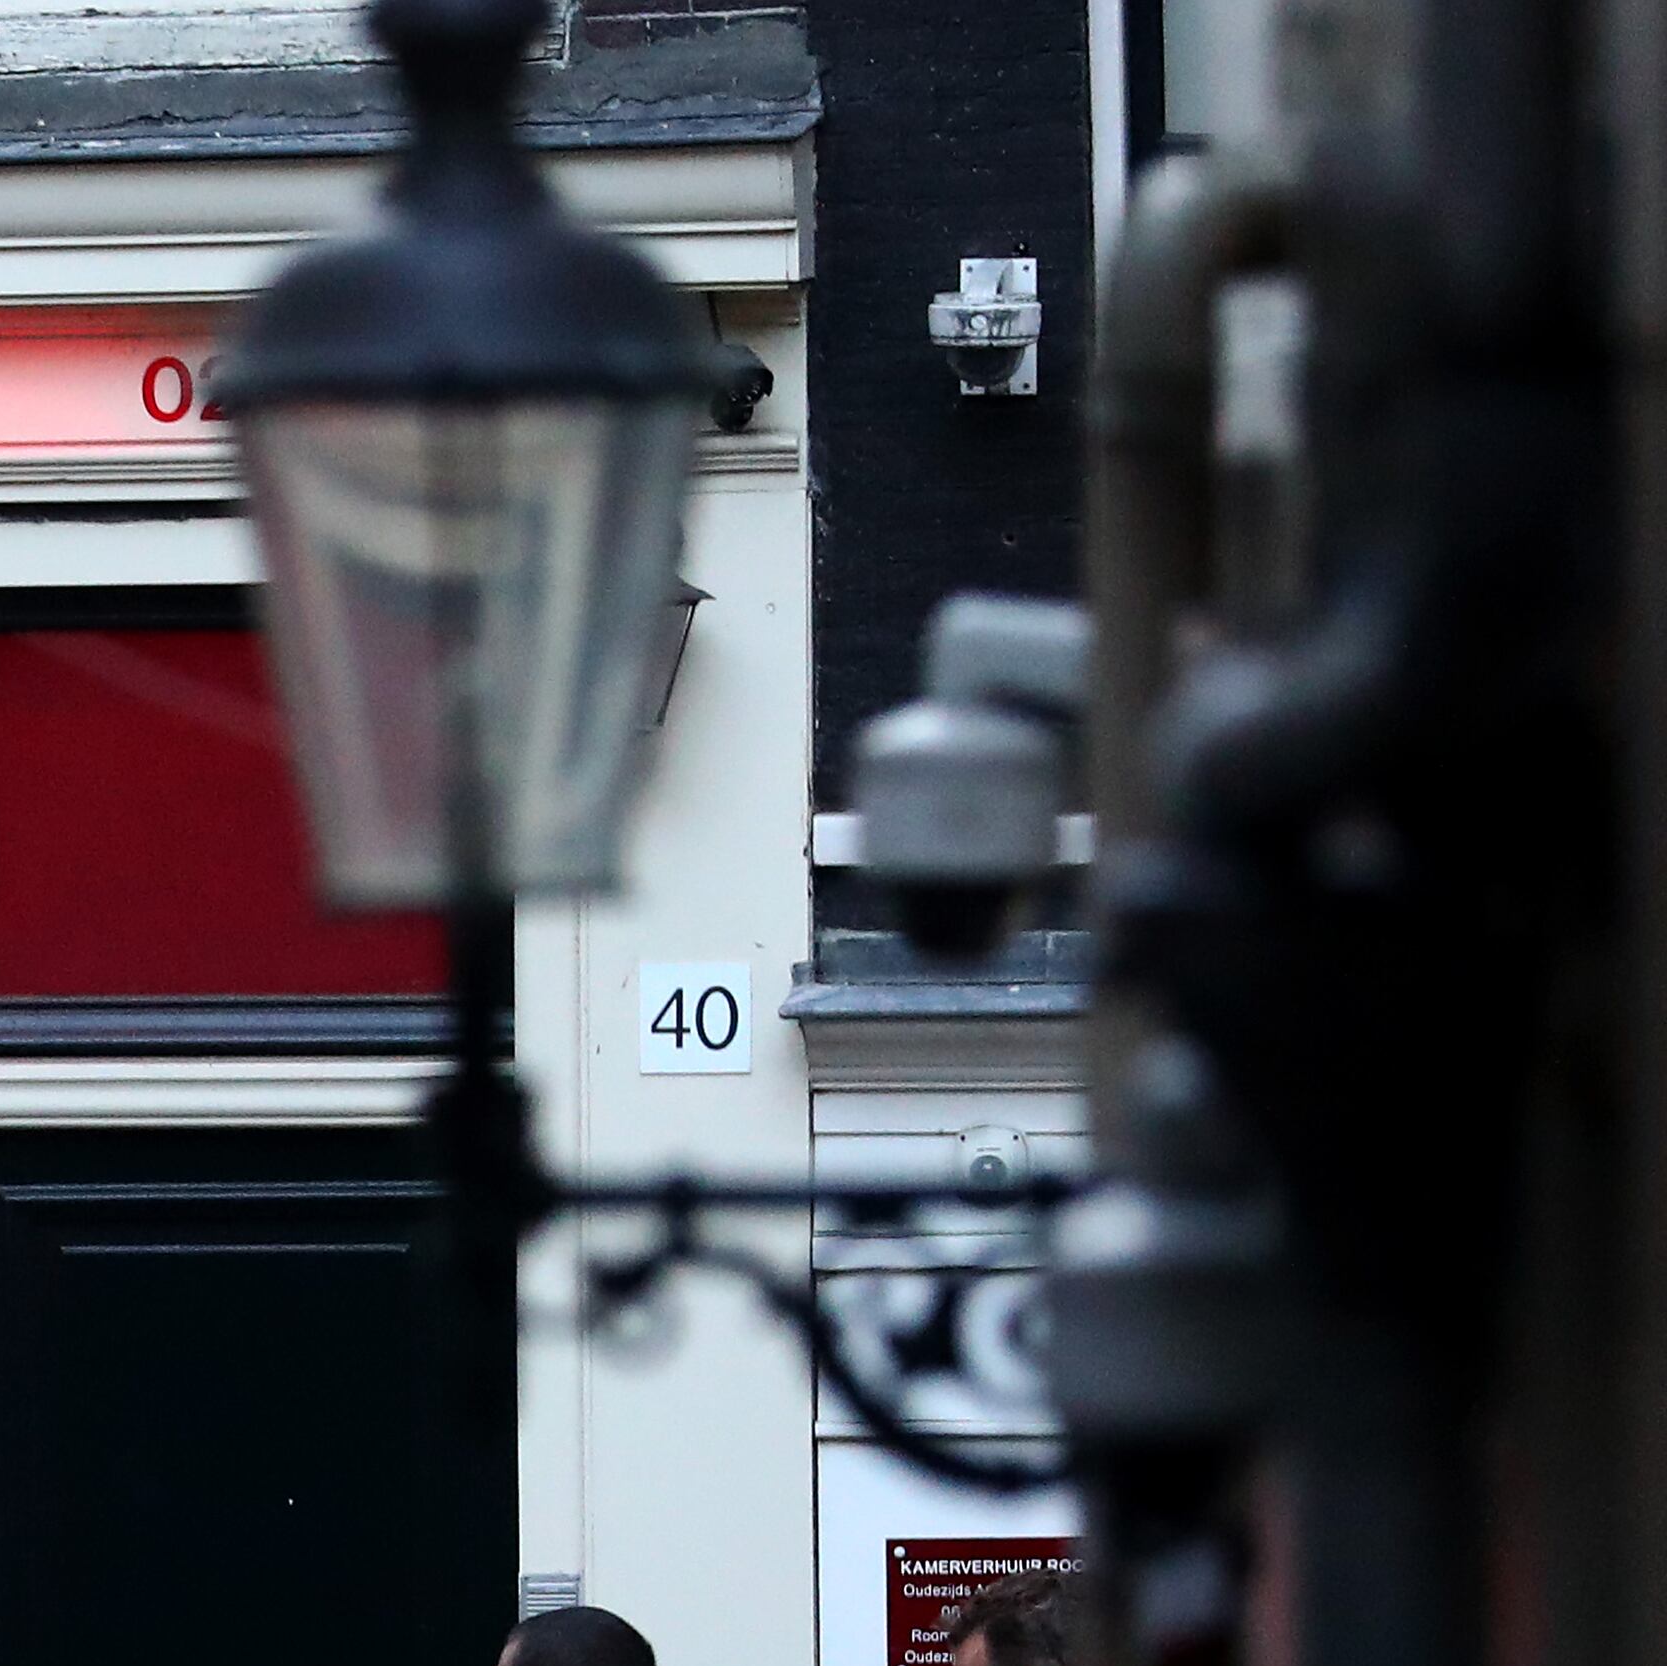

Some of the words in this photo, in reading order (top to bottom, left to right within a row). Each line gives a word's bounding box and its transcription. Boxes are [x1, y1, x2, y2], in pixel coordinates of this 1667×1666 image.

[651, 985, 739, 1051] 40
[900, 1559, 1042, 1576] KAMERVERHUUR
[903, 1583, 972, 1599] Oudezijds
[904, 1649, 957, 1666] Oudezij
